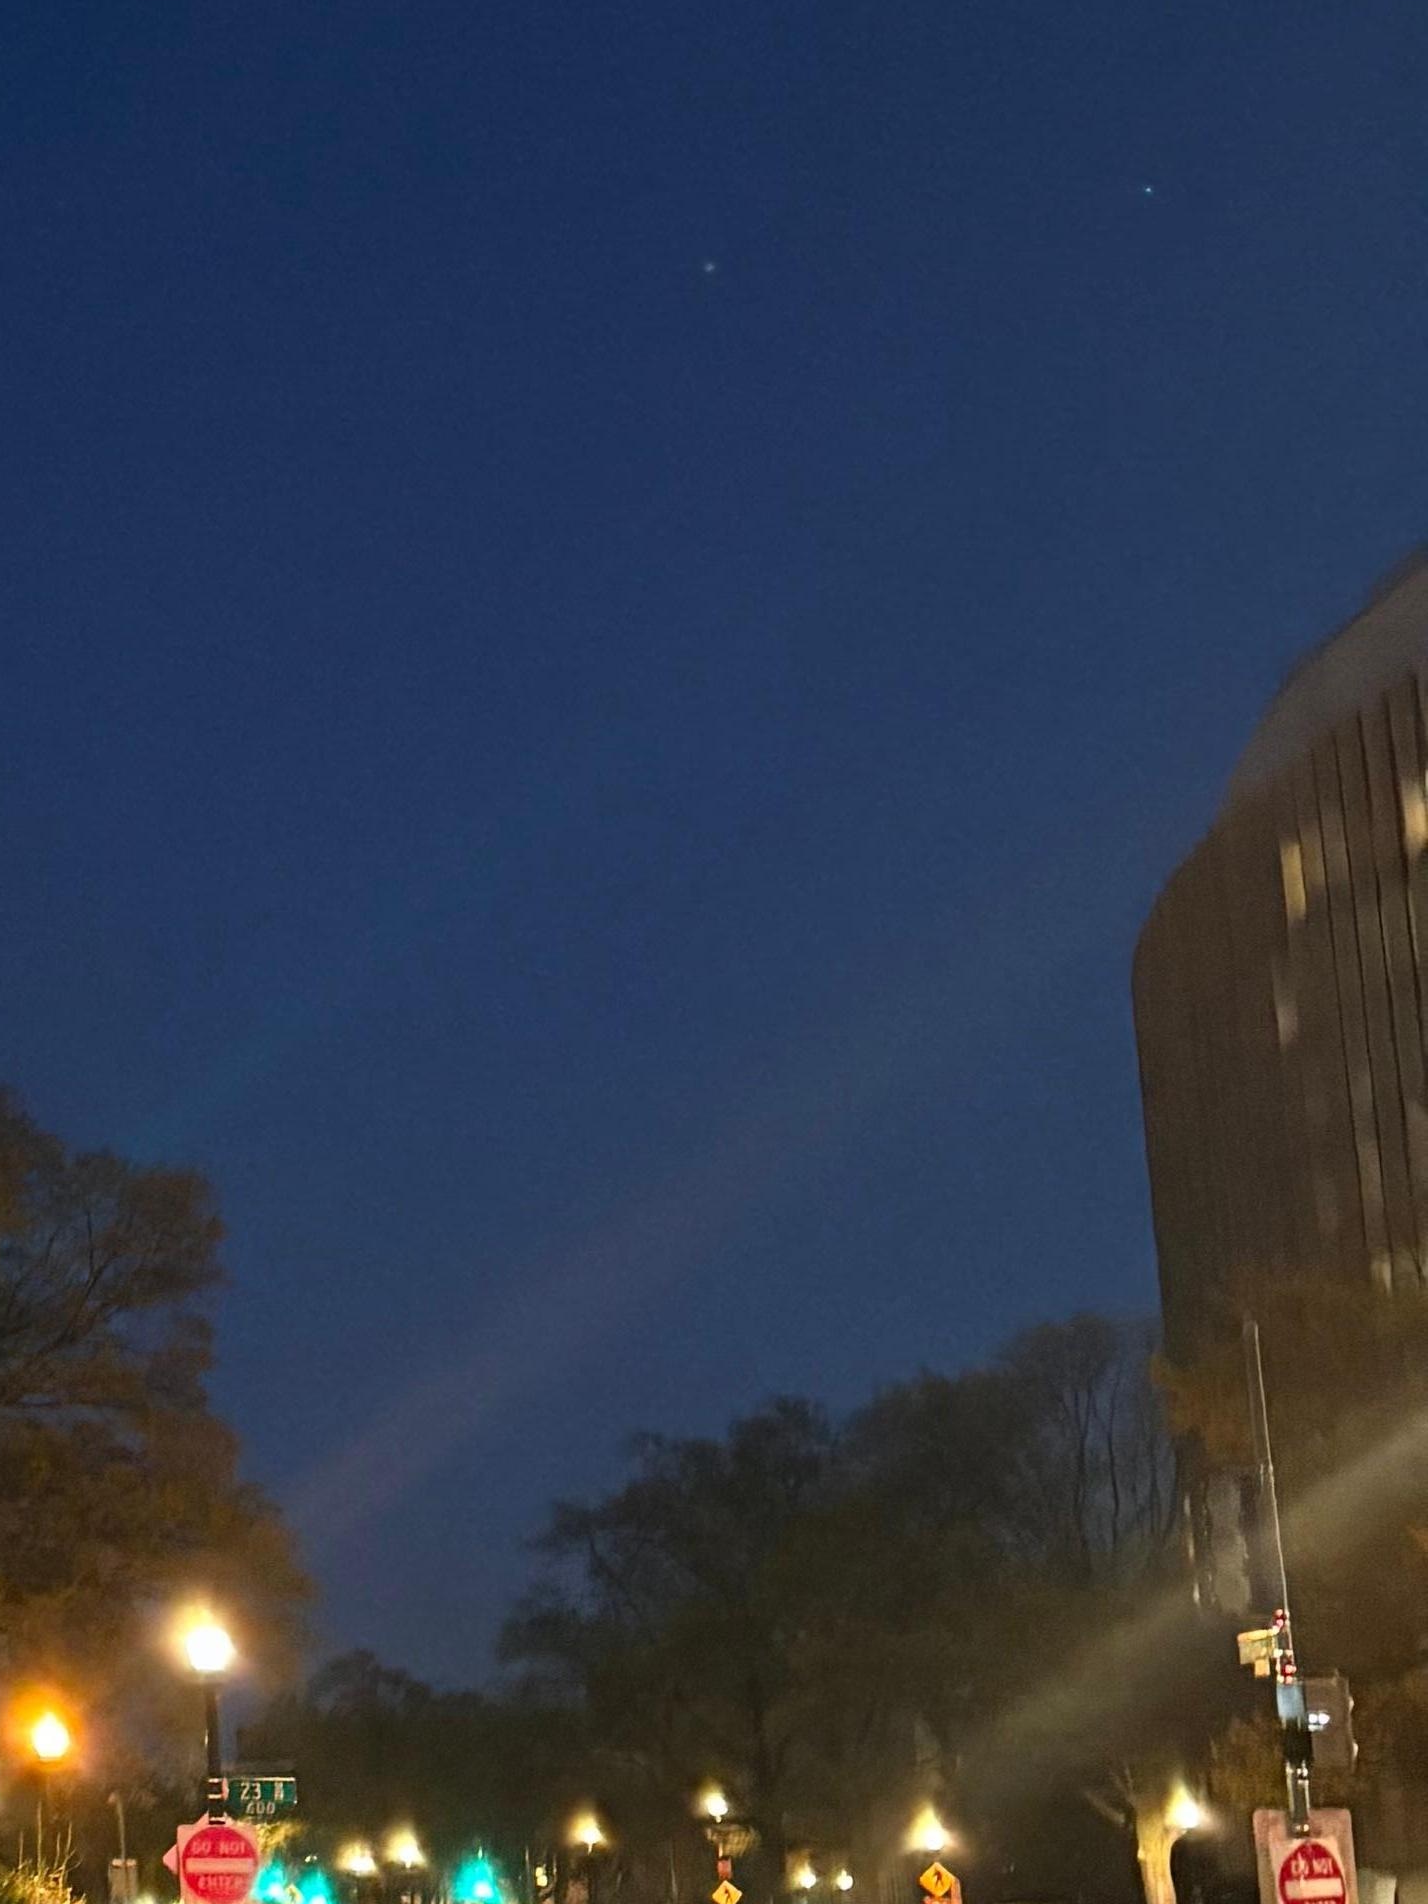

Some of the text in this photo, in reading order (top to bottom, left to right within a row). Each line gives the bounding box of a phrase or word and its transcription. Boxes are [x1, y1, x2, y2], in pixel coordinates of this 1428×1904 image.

[240, 1782, 262, 1800] 23
[191, 1840, 245, 1855] DO NOT
[1290, 1856, 1335, 1876] DO NOT
[197, 1875, 246, 1891] ENTER
